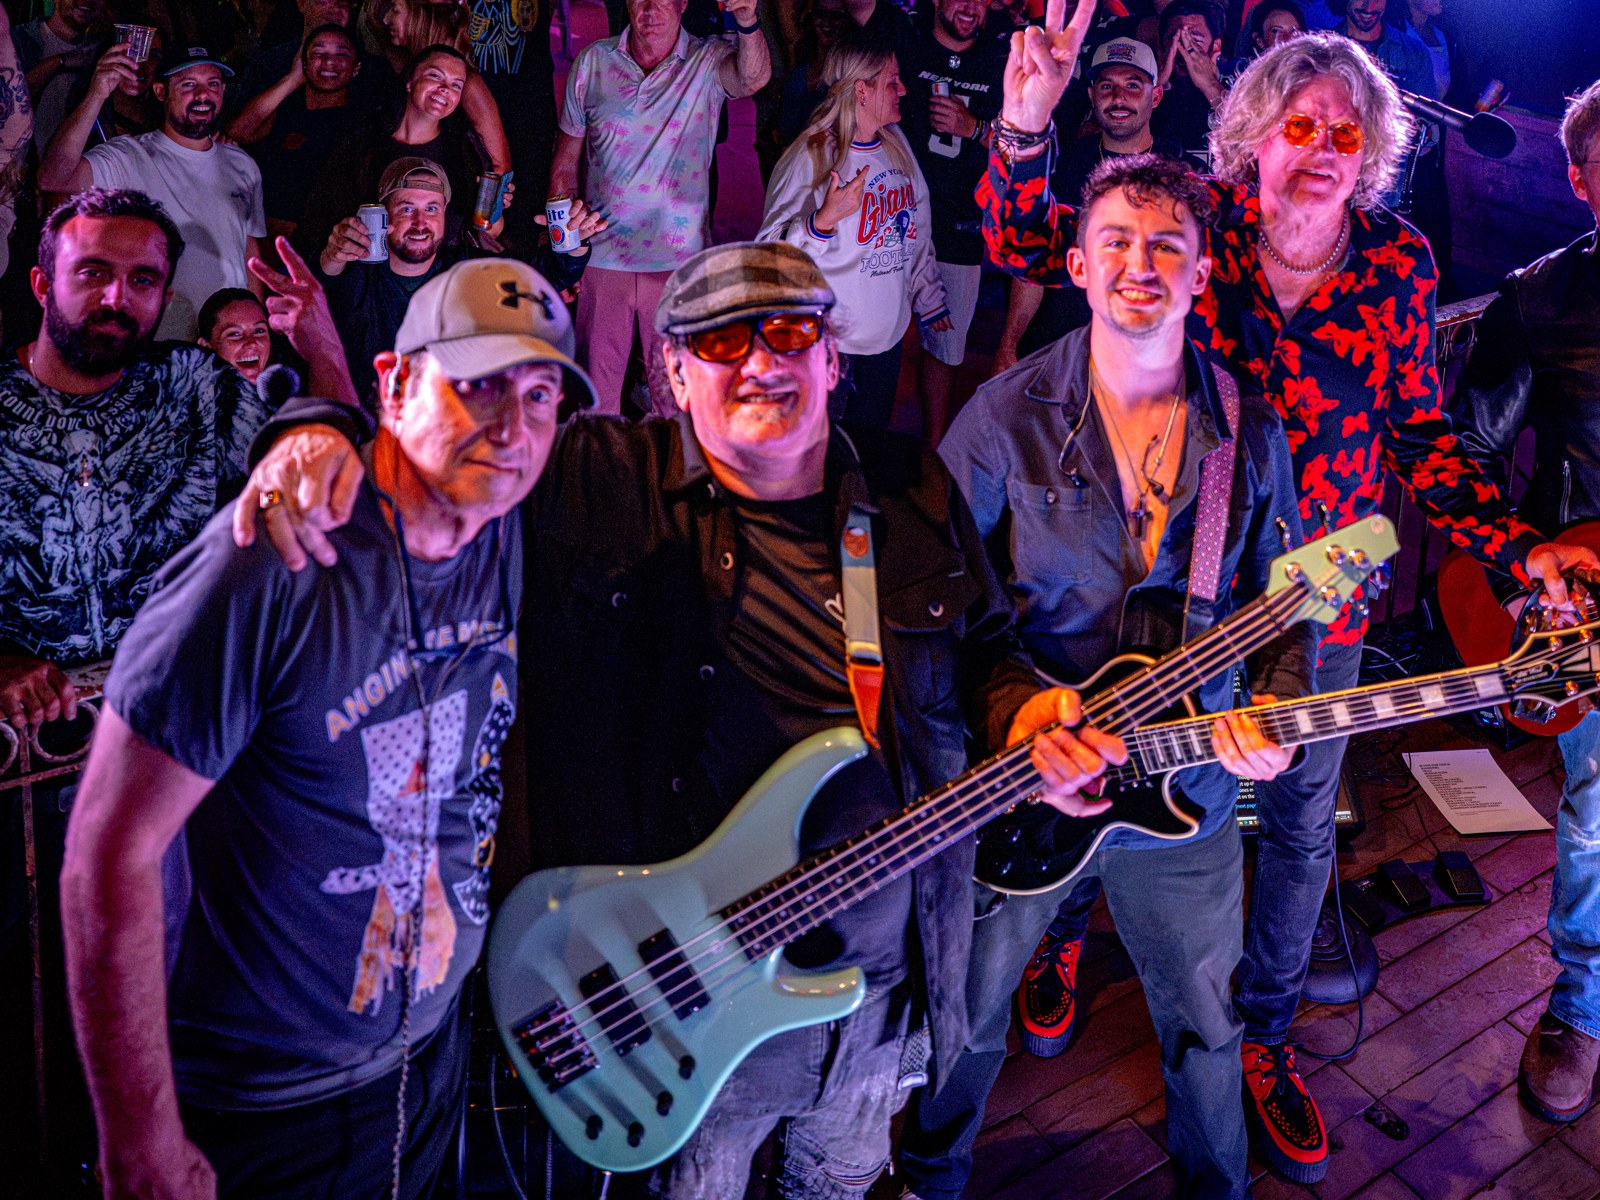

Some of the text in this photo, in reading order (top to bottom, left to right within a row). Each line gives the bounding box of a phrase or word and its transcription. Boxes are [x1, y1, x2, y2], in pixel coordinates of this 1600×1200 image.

[918, 70, 991, 93] NEW YORK
[868, 171, 887, 190] NEW
[86, 379, 146, 428] blessings
